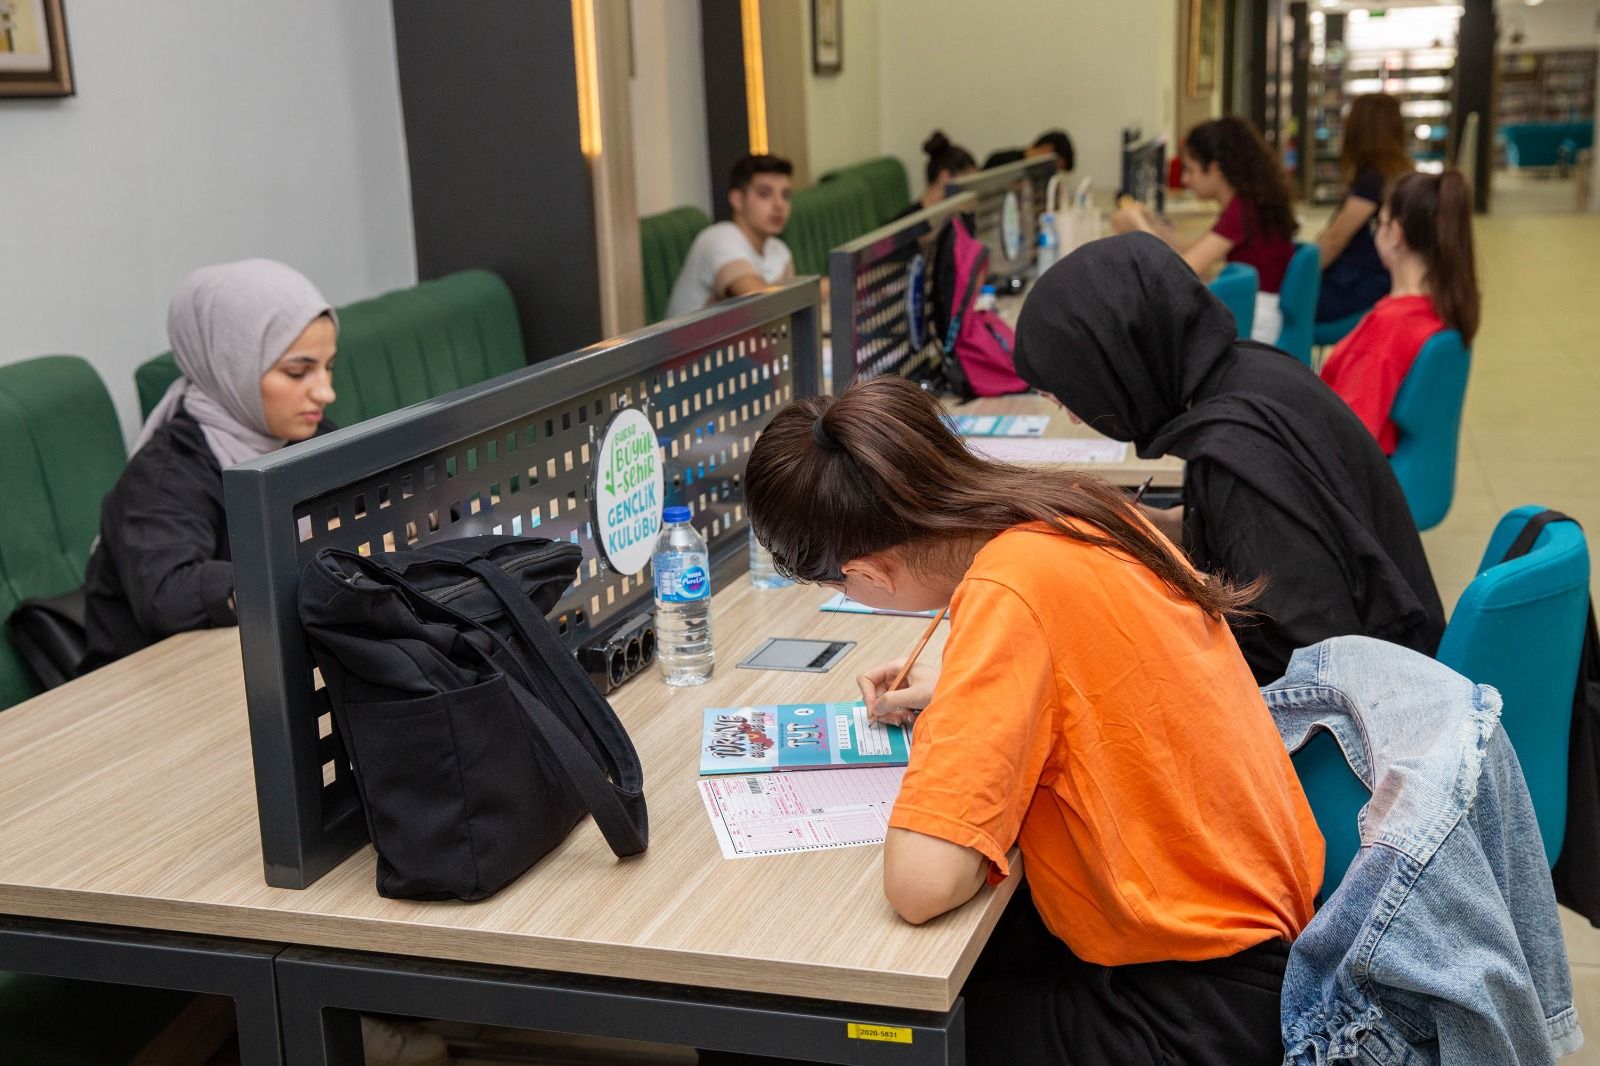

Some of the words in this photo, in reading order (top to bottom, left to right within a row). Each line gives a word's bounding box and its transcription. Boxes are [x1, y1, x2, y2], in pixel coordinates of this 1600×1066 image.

[607, 480, 657, 528] GENÇLİK
[608, 511, 658, 556] KULÜBÜ
[860, 1029, 897, 1038] 2020-5831
